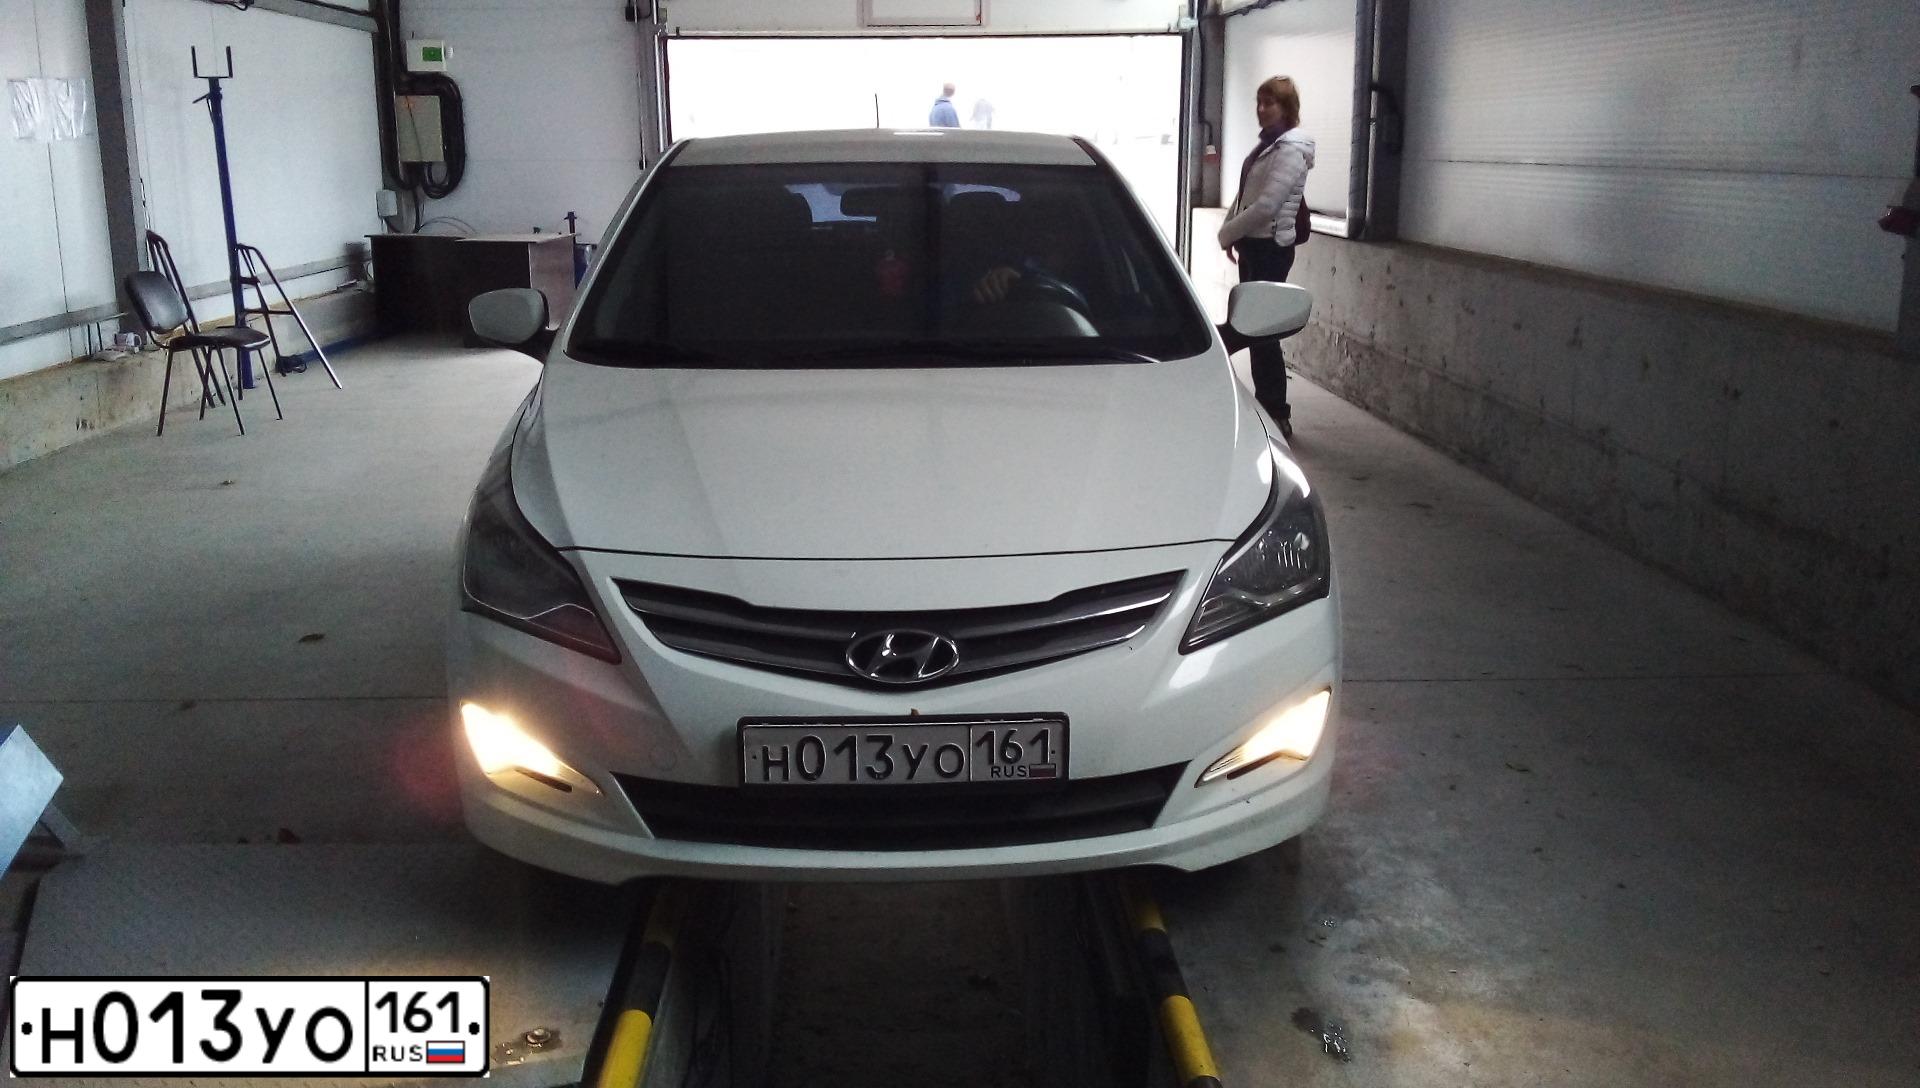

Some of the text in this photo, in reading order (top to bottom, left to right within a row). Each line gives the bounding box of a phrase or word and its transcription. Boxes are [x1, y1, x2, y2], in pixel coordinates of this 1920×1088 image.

[762, 728, 1051, 782] Н013УО 161
[990, 765, 1027, 778] RUS
